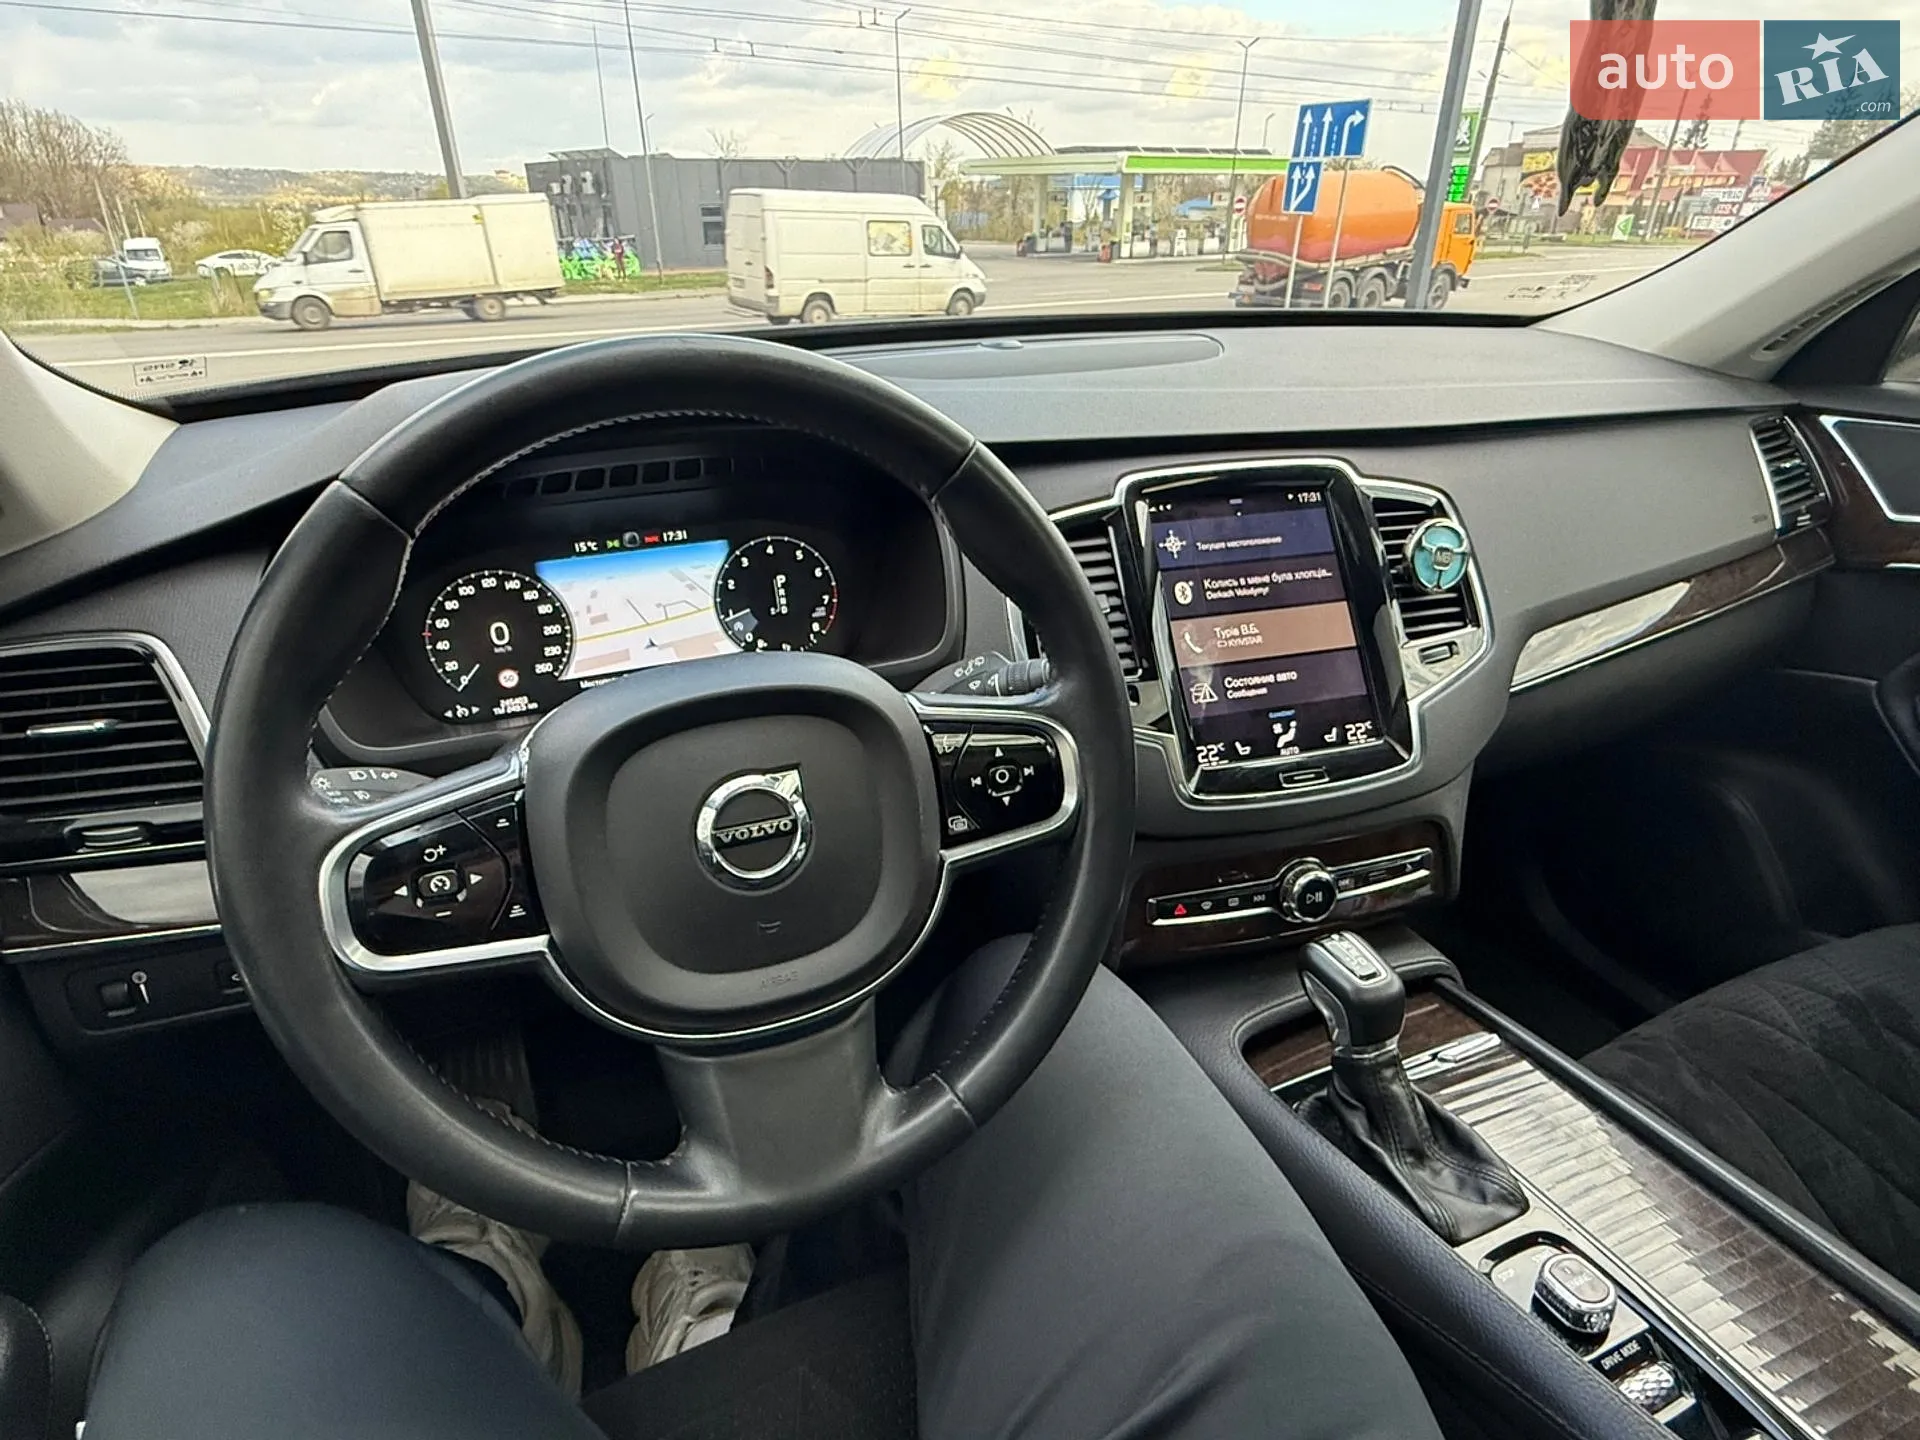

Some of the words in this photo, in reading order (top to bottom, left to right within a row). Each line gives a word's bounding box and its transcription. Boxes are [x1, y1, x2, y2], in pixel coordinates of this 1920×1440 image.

[1297, 491, 1321, 503] 17:31
[662, 529, 688, 542] 17:31
[766, 544, 774, 555] 4
[795, 549, 804, 561] 5
[740, 557, 749, 568] 3
[814, 567, 823, 578] 6
[481, 578, 497, 588] 120
[504, 579, 521, 590] 140
[727, 579, 736, 590] 2
[776, 574, 786, 588] P
[458, 585, 475, 596] 100
[523, 590, 539, 601] 160
[444, 600, 460, 611] 80
[822, 595, 830, 605] 7
[537, 604, 554, 615] 180
[435, 618, 450, 629] 60
[489, 622, 510, 646] 0
[543, 625, 562, 636] 200
[435, 640, 450, 651] 40
[544, 646, 562, 657] 230
[444, 660, 459, 671] 20
[535, 663, 554, 674] 260
[503, 674, 515, 682] 50
[716, 819, 793, 845] VOLVO
[1600, 1350, 1623, 1370] DRIVE
